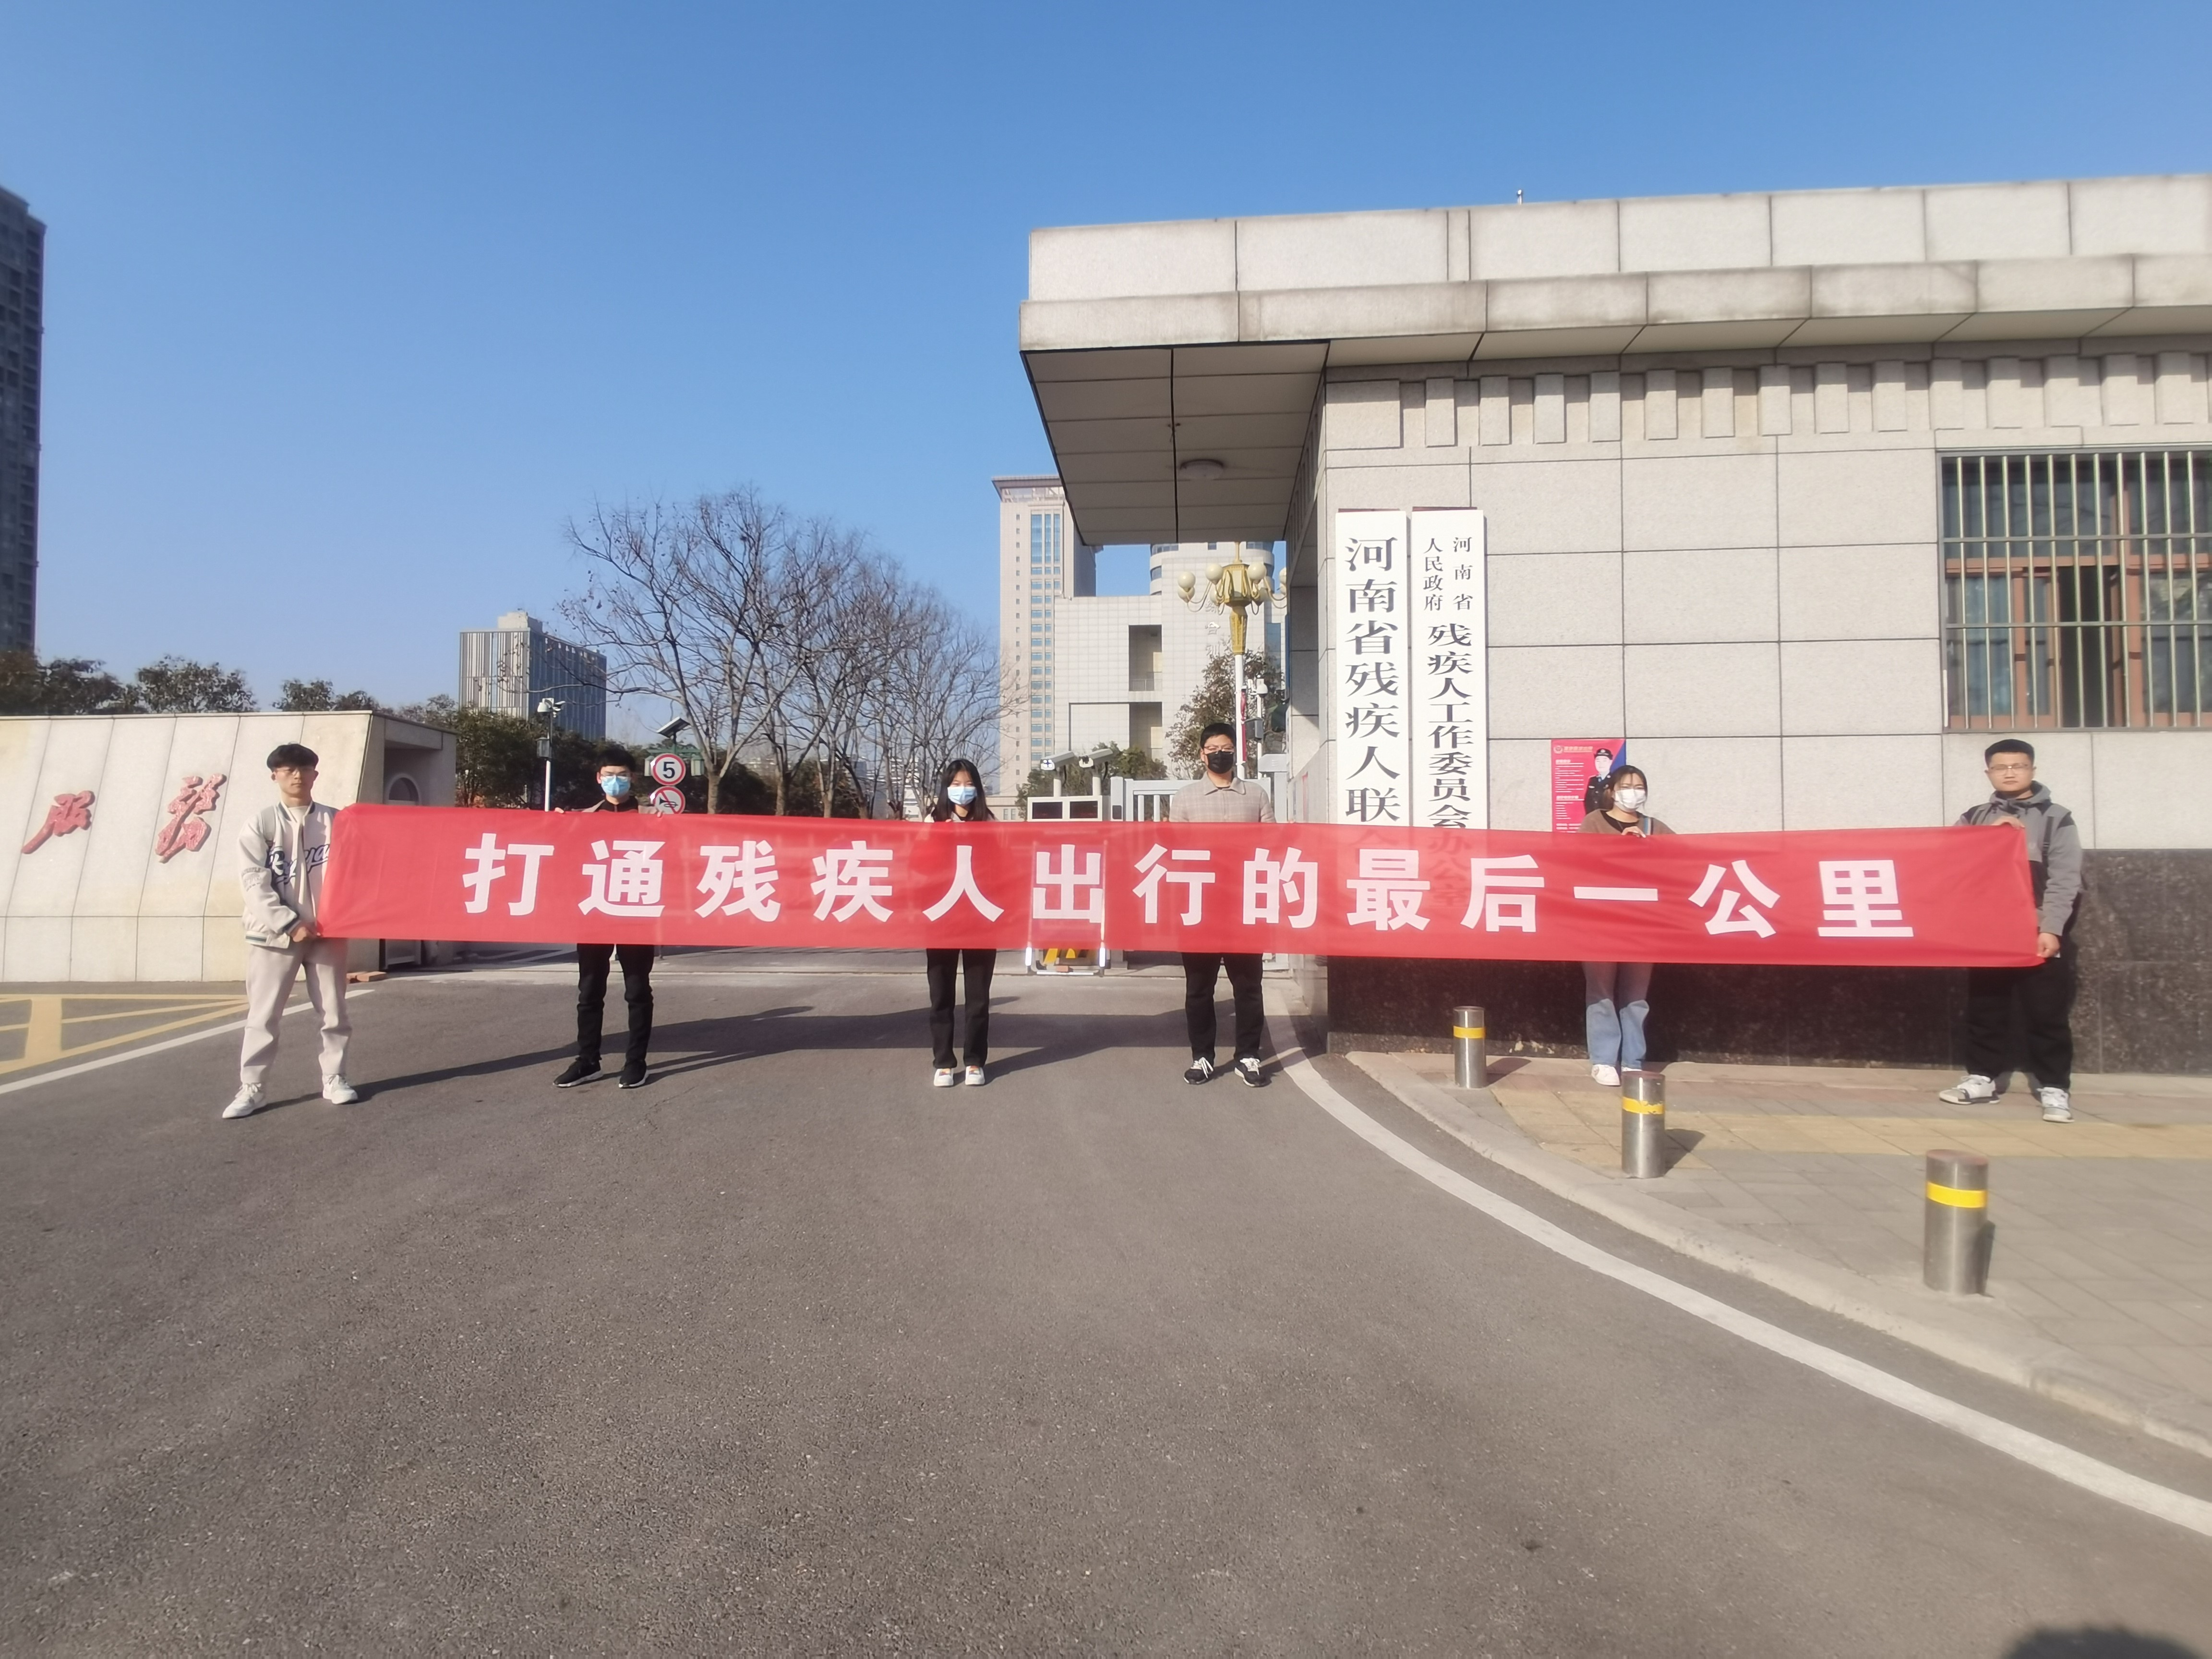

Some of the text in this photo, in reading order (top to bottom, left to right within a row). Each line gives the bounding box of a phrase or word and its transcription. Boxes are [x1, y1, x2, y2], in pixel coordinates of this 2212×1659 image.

[1423, 537, 1444, 612] 人民政府
[1452, 536, 1474, 611] 河南省
[663, 761, 675, 779] 5
[462, 832, 1914, 938] 打通残疾人出行的最后一公里
